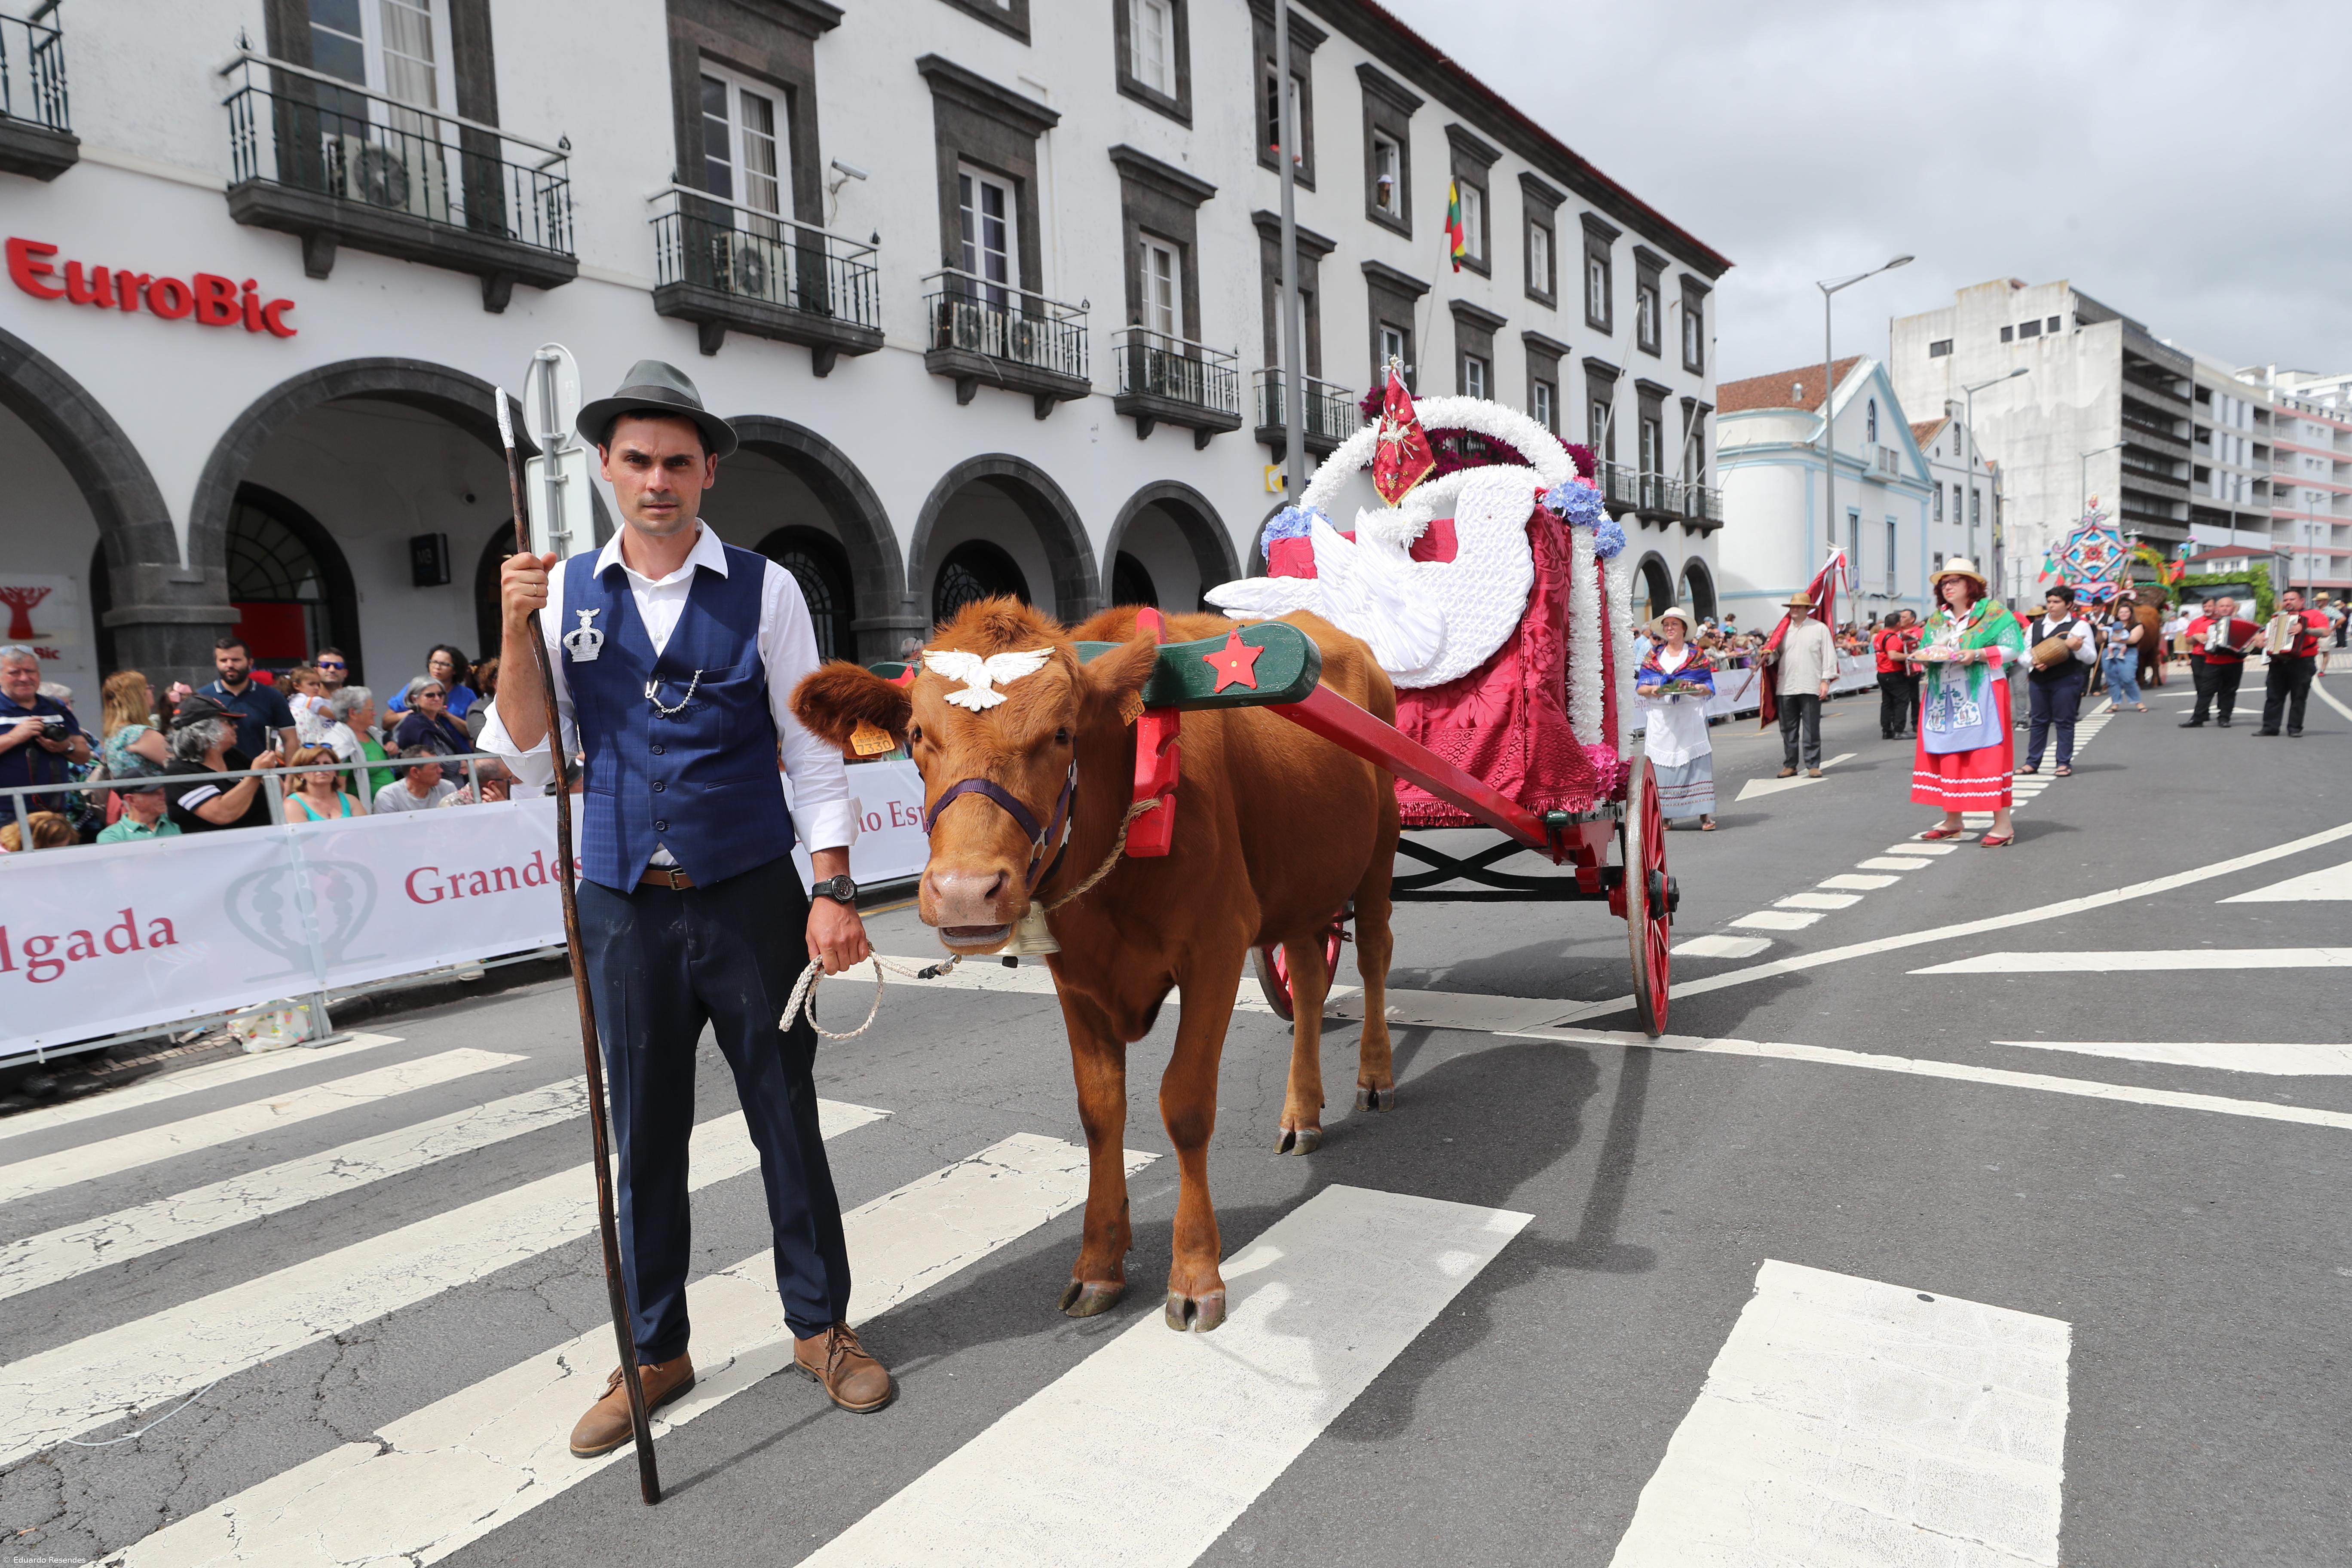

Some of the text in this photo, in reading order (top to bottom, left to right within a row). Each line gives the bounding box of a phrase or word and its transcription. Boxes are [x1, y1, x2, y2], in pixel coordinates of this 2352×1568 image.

[5, 236, 298, 337] EuroBic
[1123, 701, 1143, 724] 7330
[856, 740, 891, 754] 7330
[405, 849, 583, 905] Grandes
